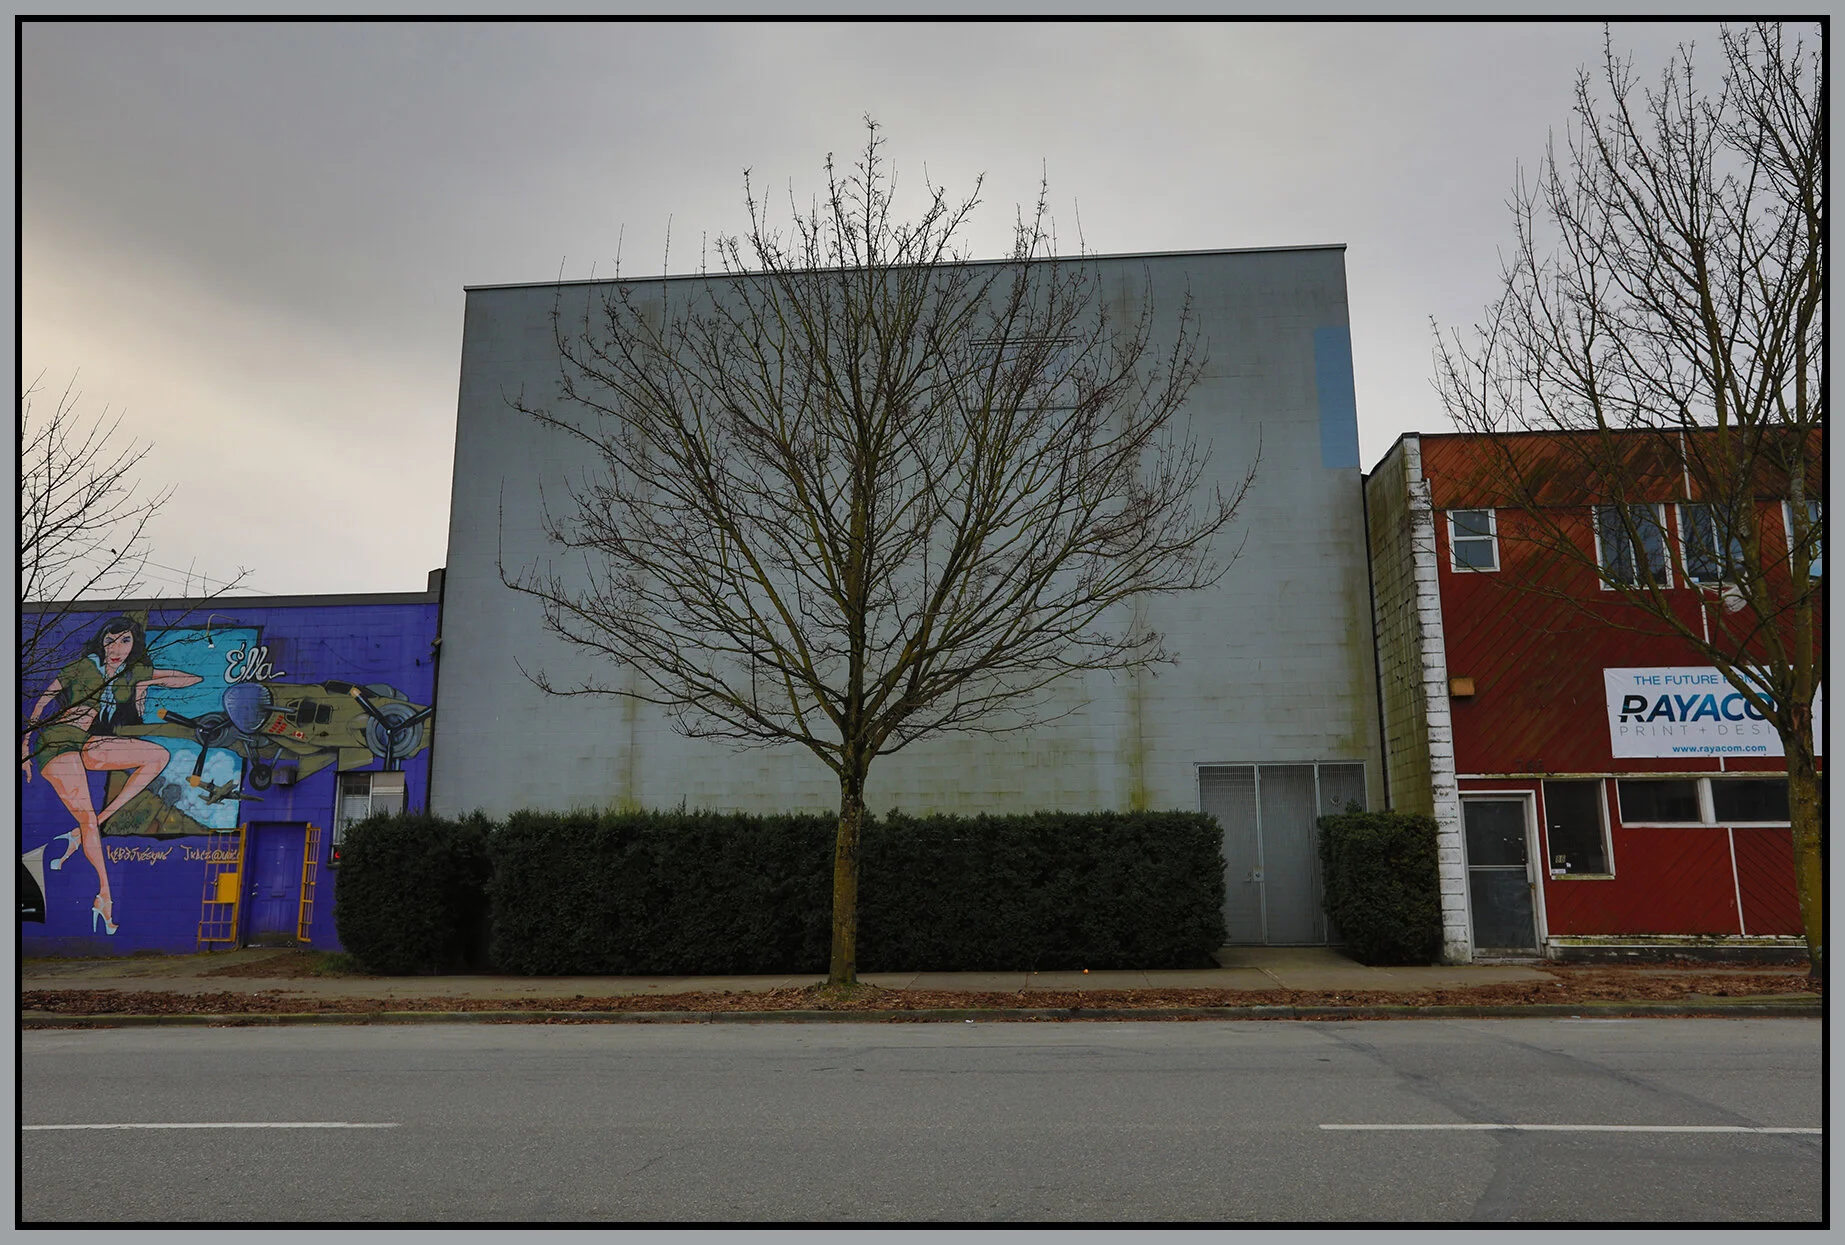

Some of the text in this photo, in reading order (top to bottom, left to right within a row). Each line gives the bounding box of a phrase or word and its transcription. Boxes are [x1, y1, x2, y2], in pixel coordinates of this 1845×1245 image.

[1634, 675, 1661, 686] THE
[1665, 674, 1718, 685] FUTURE
[1617, 692, 1775, 723] RAYACO
[1620, 725, 1688, 736] PRINT
[1717, 723, 1771, 736] DESI
[1672, 744, 1767, 753] www.rayacom.com
